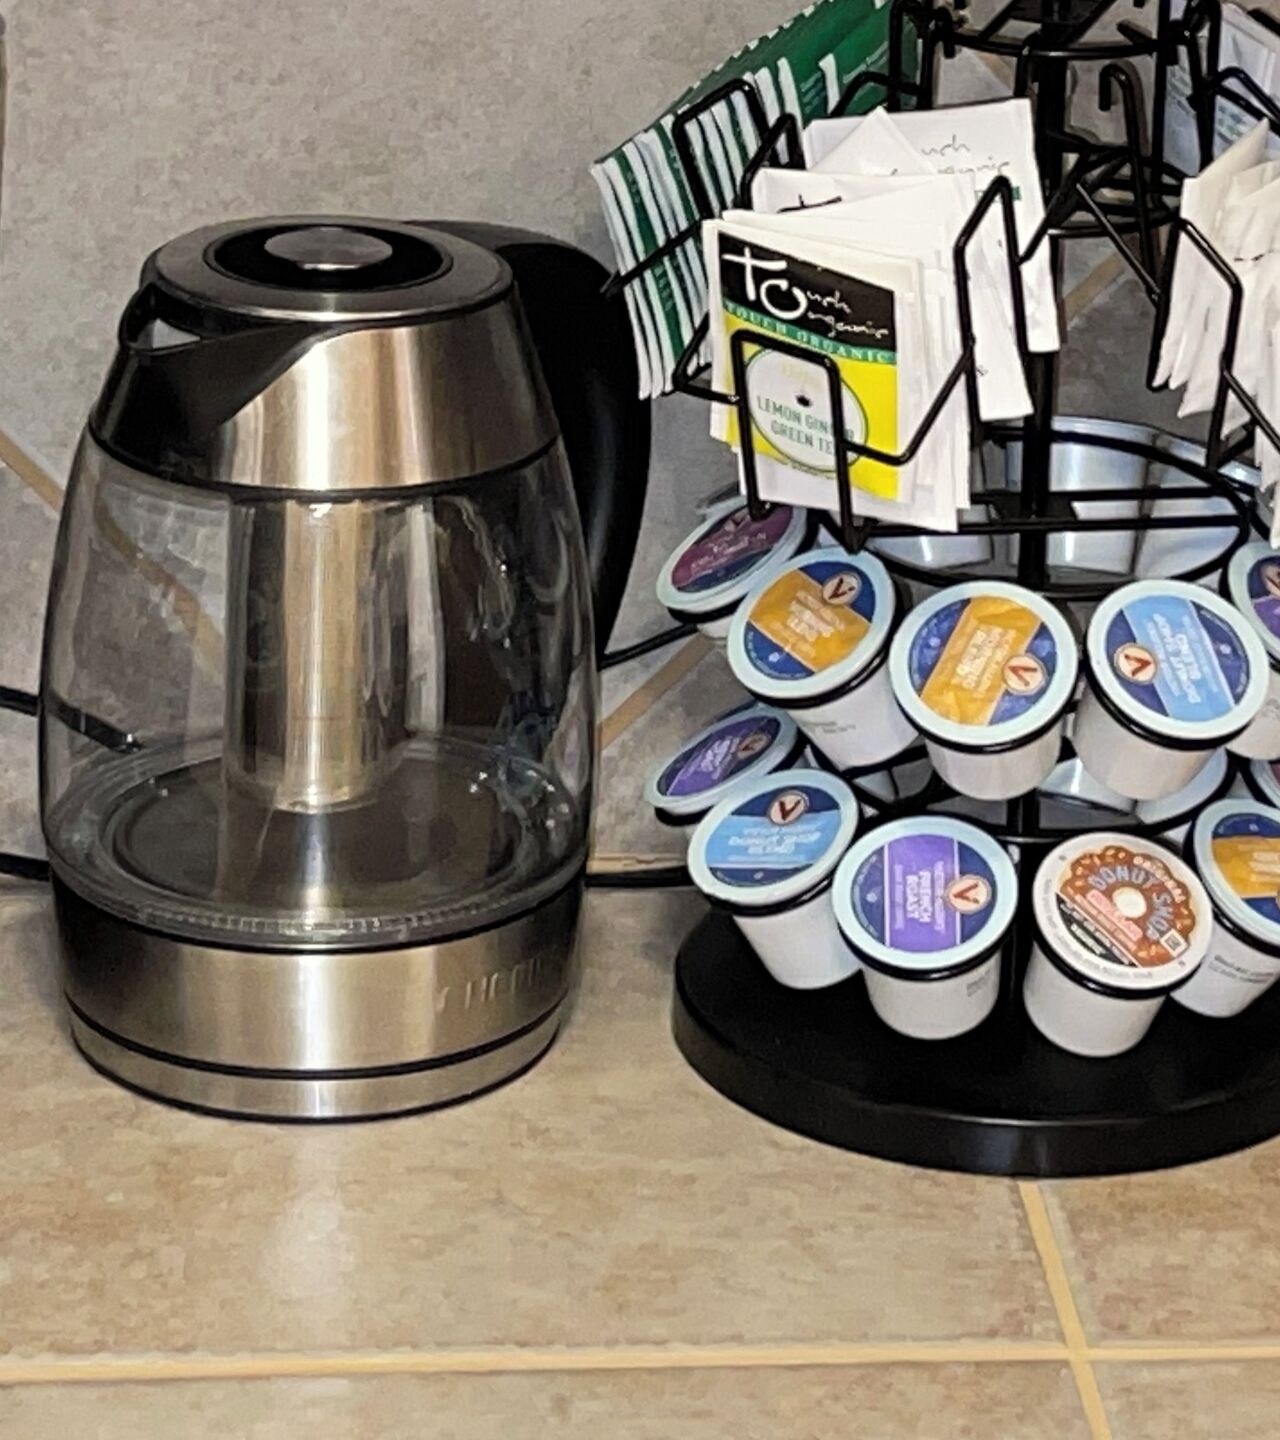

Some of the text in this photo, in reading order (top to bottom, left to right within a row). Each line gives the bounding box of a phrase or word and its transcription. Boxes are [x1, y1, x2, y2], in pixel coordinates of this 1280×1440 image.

[796, 329, 890, 363] ORGANIC
[757, 395, 855, 441] LEMON GINR
[770, 420, 815, 448] GREEN
[1087, 864, 1158, 892] DONUT
[904, 874, 920, 919] ROAST
